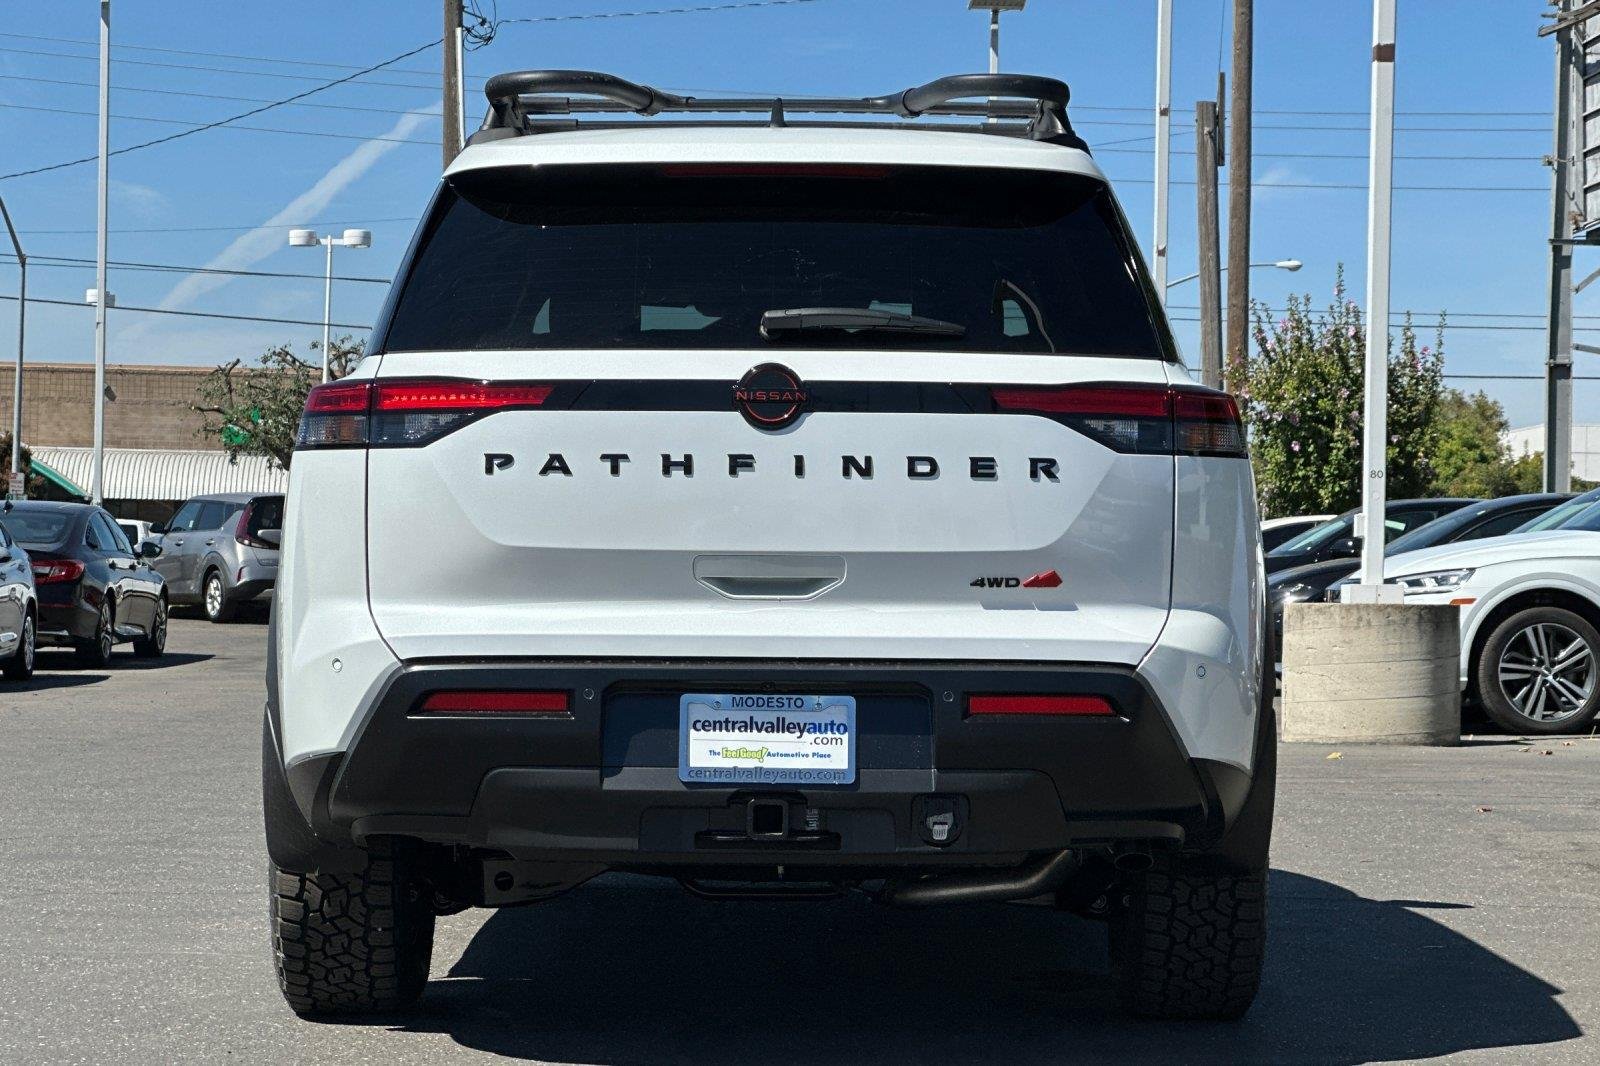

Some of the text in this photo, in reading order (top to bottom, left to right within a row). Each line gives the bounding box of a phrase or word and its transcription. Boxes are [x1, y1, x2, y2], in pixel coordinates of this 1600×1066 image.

[735, 391, 807, 401] NISSAN
[483, 452, 1061, 483] PATHFINDER
[1370, 470, 1384, 479] 80
[969, 577, 1021, 588] 4WD
[732, 696, 804, 709] MODESTO
[692, 716, 848, 739] centralvalleyauto
[767, 751, 810, 759] Automotive
[688, 766, 847, 784] centralvalleyauto.com
